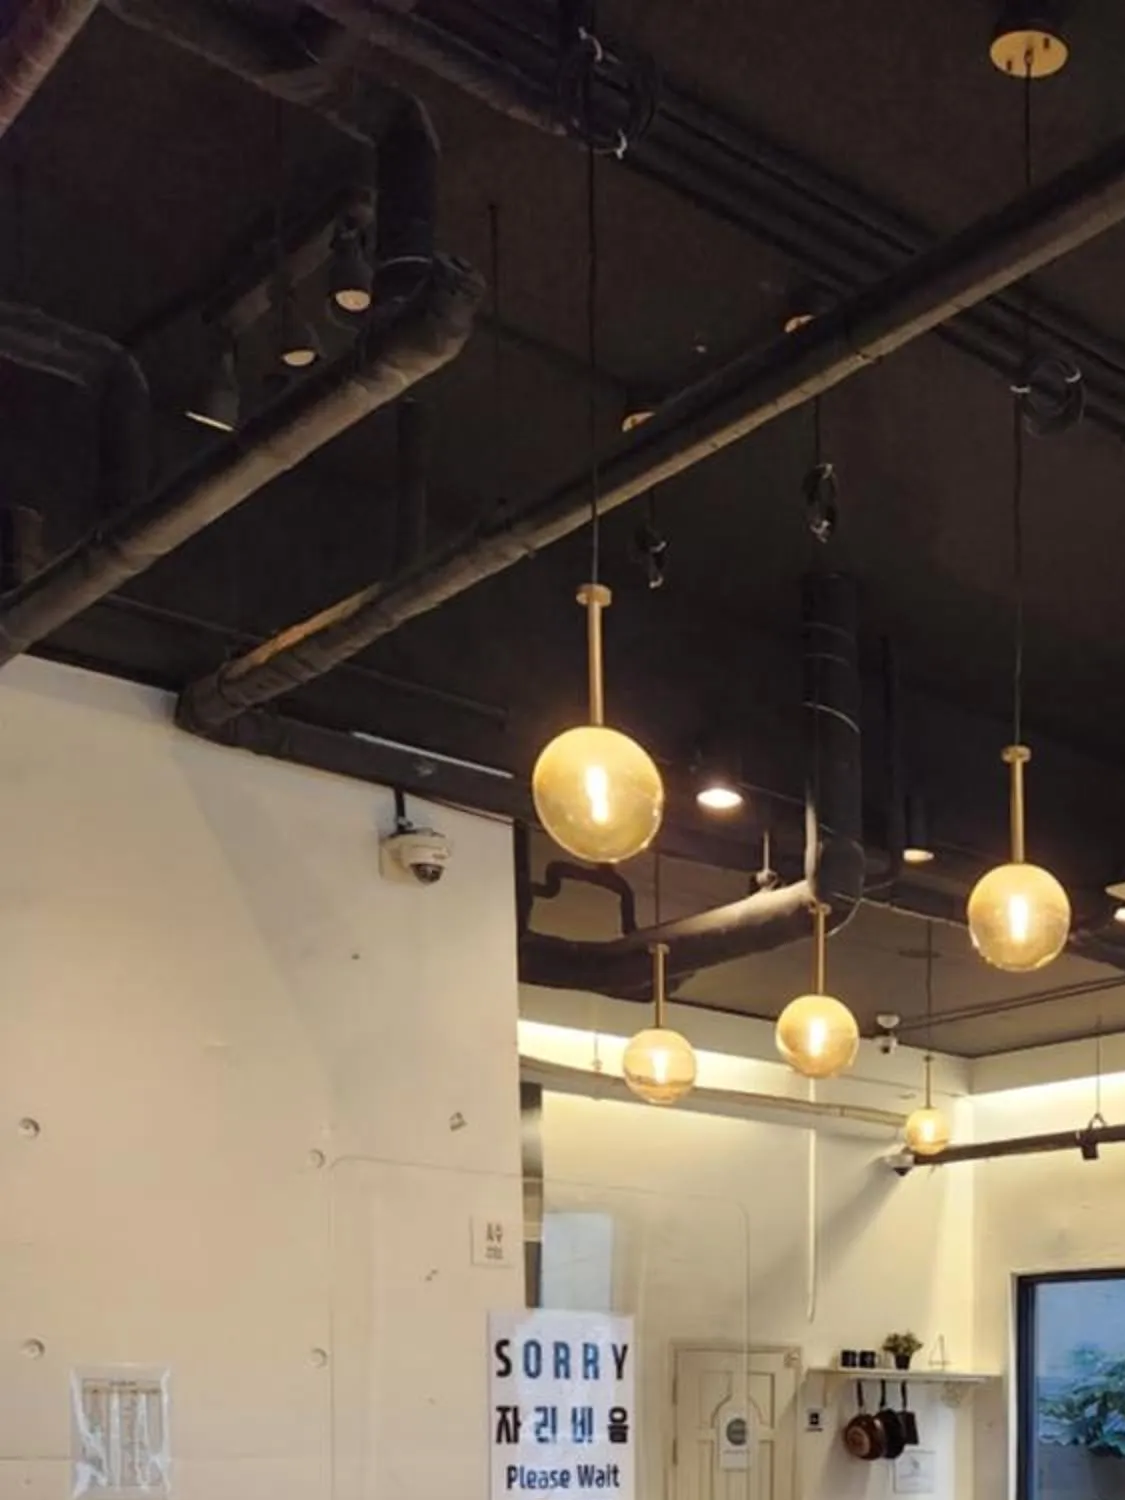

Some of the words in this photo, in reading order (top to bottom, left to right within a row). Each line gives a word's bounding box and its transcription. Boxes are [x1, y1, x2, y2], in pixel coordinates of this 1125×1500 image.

[494, 1338, 629, 1381] SORRY
[506, 1465, 571, 1490] Please
[578, 1464, 621, 1489] Wait
